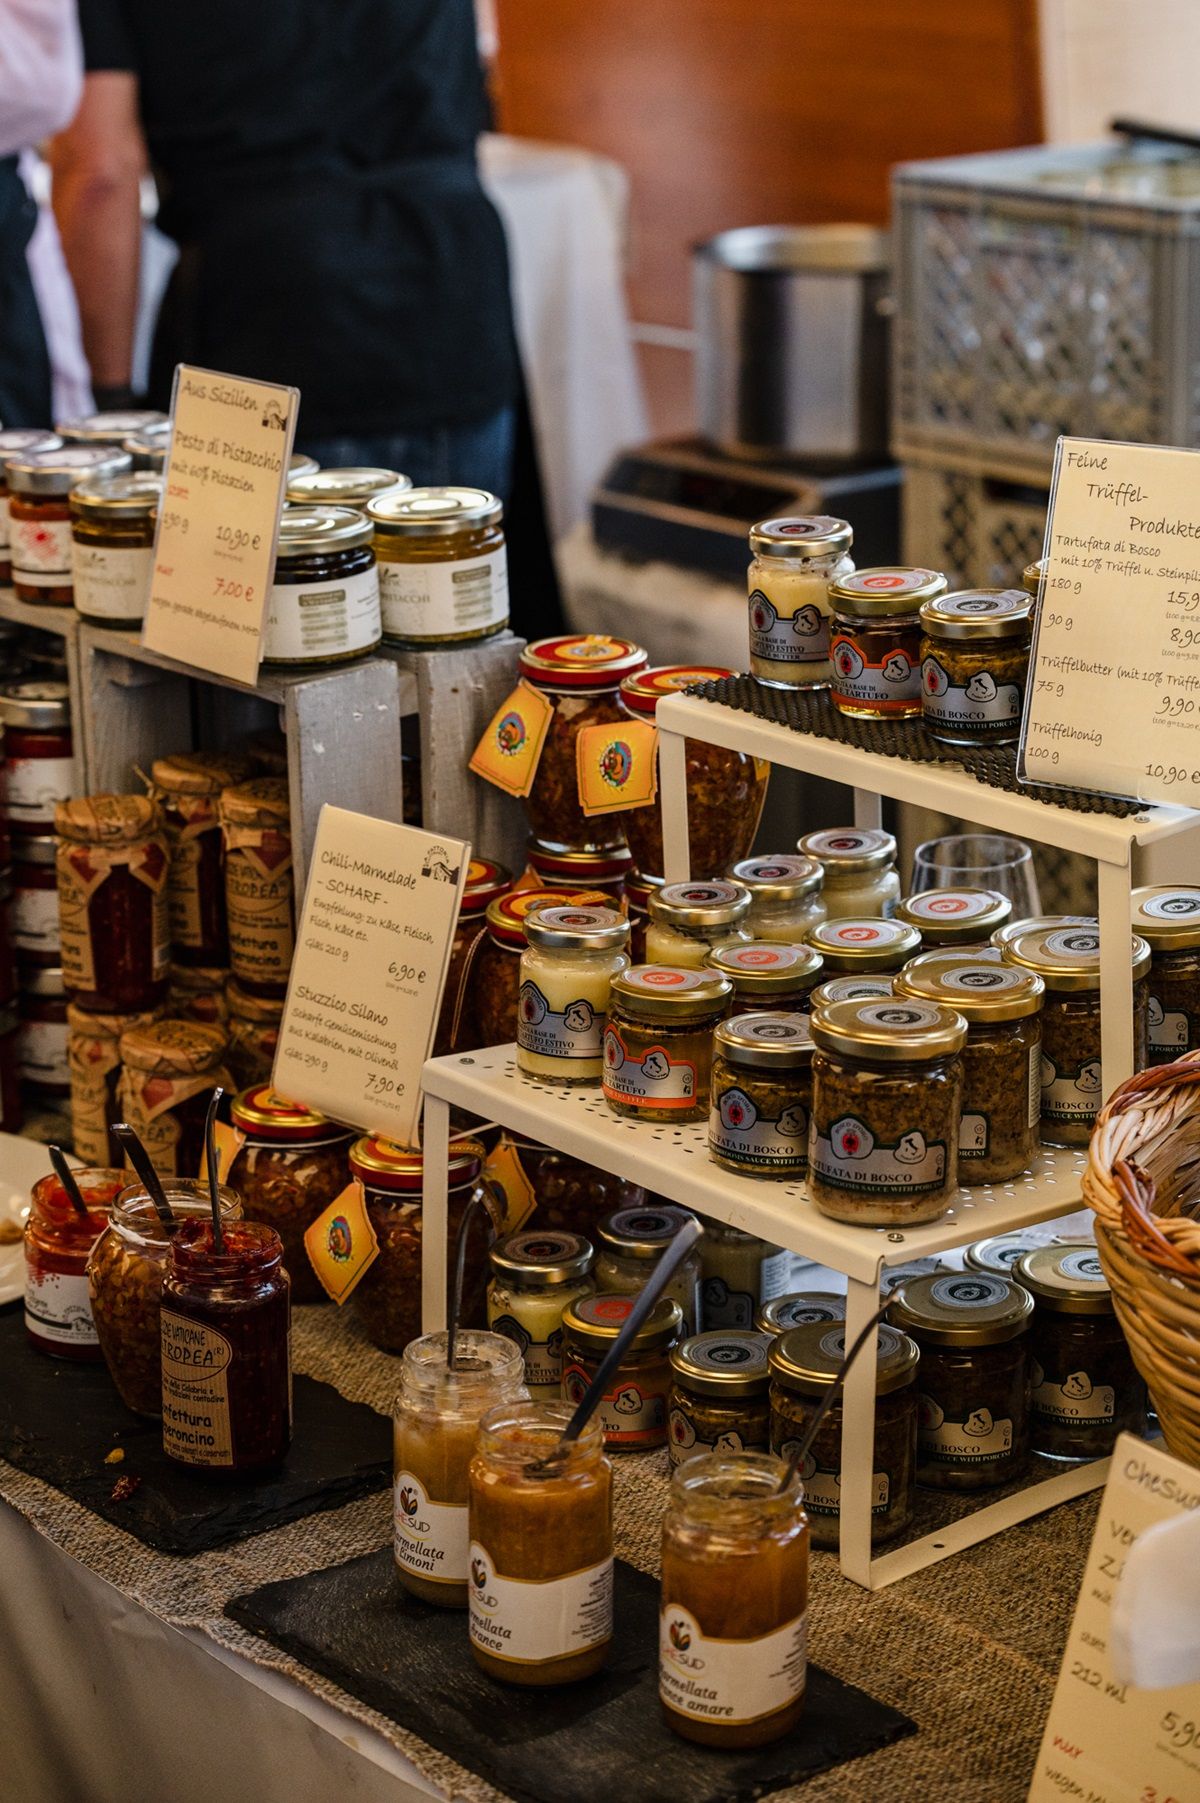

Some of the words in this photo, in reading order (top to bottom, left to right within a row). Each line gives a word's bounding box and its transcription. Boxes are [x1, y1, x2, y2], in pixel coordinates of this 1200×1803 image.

[181, 380, 206, 400] Aus
[208, 385, 258, 411] Sizilien
[175, 430, 204, 452] Pesto
[207, 438, 219, 455] di
[222, 442, 282, 473] Pistacchio
[1067, 451, 1108, 471] Feine
[171, 460, 188, 475] mit
[211, 469, 255, 492] Pistazien
[1086, 482, 1149, 507] Trüffel-
[215, 526, 250, 551] 10,90
[251, 535, 262, 551] €
[1056, 535, 1111, 553] Tartufata
[1113, 540, 1126, 553] di
[1128, 542, 1161, 558] Bosco
[1061, 555, 1080, 567] mit
[1081, 558, 1103, 574] 10%
[1105, 561, 1141, 577] Trüffel
[1144, 568, 1154, 576] u.
[213, 577, 243, 598] 7,00
[245, 586, 255, 602] €
[1050, 578, 1071, 590] 180
[1073, 581, 1082, 595] g
[1167, 590, 1200, 611] 15,9
[1044, 613, 1063, 629] 90
[1065, 617, 1073, 631] g
[1041, 655, 1114, 676] Trüffelbutter
[1117, 666, 1140, 681] (mit
[1142, 671, 1164, 688] 10%
[1167, 675, 1200, 692] Trüffe
[845, 689, 889, 700] TARTUFO
[1037, 680, 1054, 692] 75
[1056, 684, 1065, 698] g
[936, 708, 947, 717] DI
[948, 710, 986, 720] BOSCO
[1155, 696, 1195, 717] 9,90
[1032, 722, 1103, 747] Trüffelhonig
[1028, 746, 1050, 759] 100
[1051, 751, 1060, 765] g
[1145, 763, 1188, 785] 10,90
[320, 850, 417, 891] Chili-Marmelade
[325, 879, 382, 905] SCHARF
[334, 921, 354, 939] Käse
[366, 915, 378, 927] zu
[403, 925, 435, 945] Fleisch,
[342, 949, 350, 962] g
[388, 961, 416, 982] 6,90
[418, 969, 427, 983] €
[294, 985, 347, 1013] Stuzzico
[347, 1003, 389, 1026] Silano
[291, 1007, 323, 1028] Scharfe
[324, 1019, 397, 1054] Gemüsemischung
[545, 1038, 575, 1048] ESTIVO
[321, 1060, 329, 1073] g
[347, 1046, 363, 1059] mit
[364, 1052, 400, 1071] Olivenöl
[364, 1072, 394, 1094] 7,90
[396, 1083, 406, 1096] €
[609, 1080, 646, 1096] TARTUFO
[1055, 1101, 1095, 1110] BOSCO
[739, 1142, 750, 1152] DI
[753, 1145, 794, 1155] BOSCO
[854, 1172, 867, 1181] DI
[870, 1173, 913, 1183] BOSCO
[1041, 1403, 1079, 1416] BOSCO
[941, 1444, 982, 1454] BOSCO
[408, 1517, 431, 1533] SUD
[477, 1590, 499, 1608] SUD
[679, 1653, 705, 1670] SUD
[687, 1700, 735, 1717] amare
